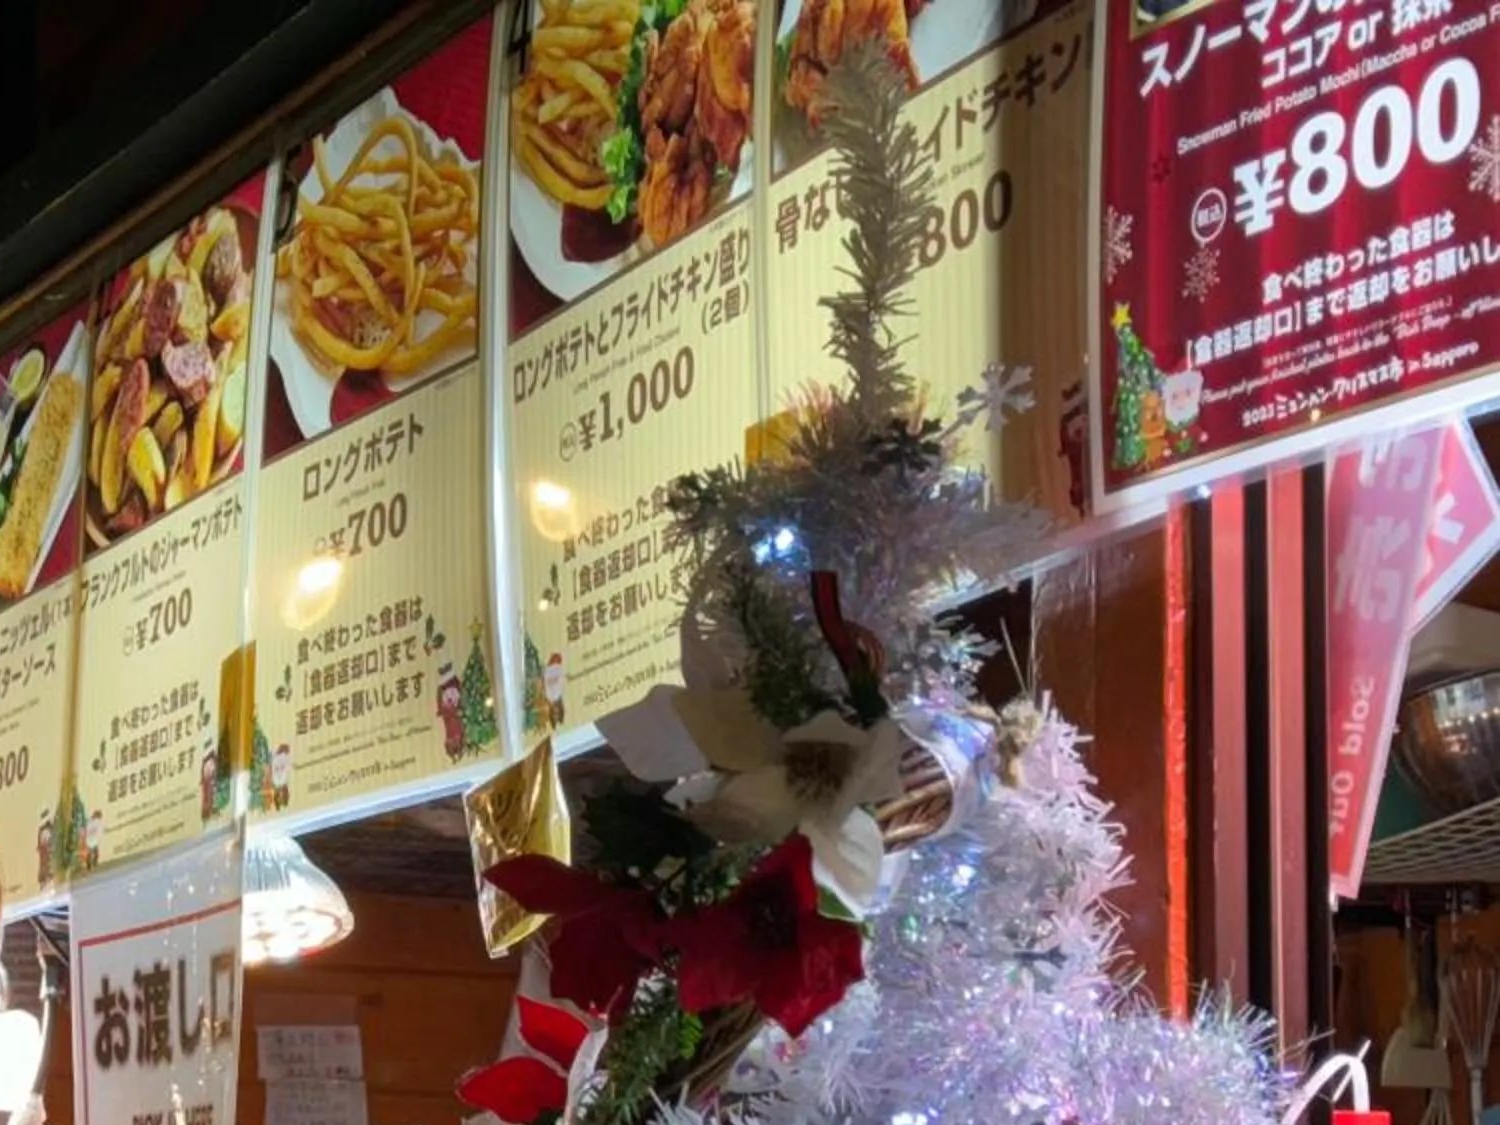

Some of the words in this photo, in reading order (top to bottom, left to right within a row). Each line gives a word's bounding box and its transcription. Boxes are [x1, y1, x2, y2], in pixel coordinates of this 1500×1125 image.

[1177, 118, 1237, 155] Snowman
[1239, 101, 1272, 129] Fried
[1274, 84, 1318, 114] Potato
[1420, 33, 1437, 53] or
[1439, 12, 1488, 45] Cocoa
[1262, 21, 1343, 88] ココア
[1348, 10, 1384, 50] or
[1233, 57, 1482, 238] ¥800
[1262, 210, 1456, 305] 食べ終わった食器は
[513, 228, 751, 405] ロングポテトとフライドチキン盛り
[701, 280, 750, 335] (2個)
[578, 346, 695, 451] ¥1,000
[303, 412, 424, 501] ロングポテト
[329, 492, 408, 557] ¥700
[136, 587, 193, 651] ¥700
[94, 948, 236, 1070] お渡し口
